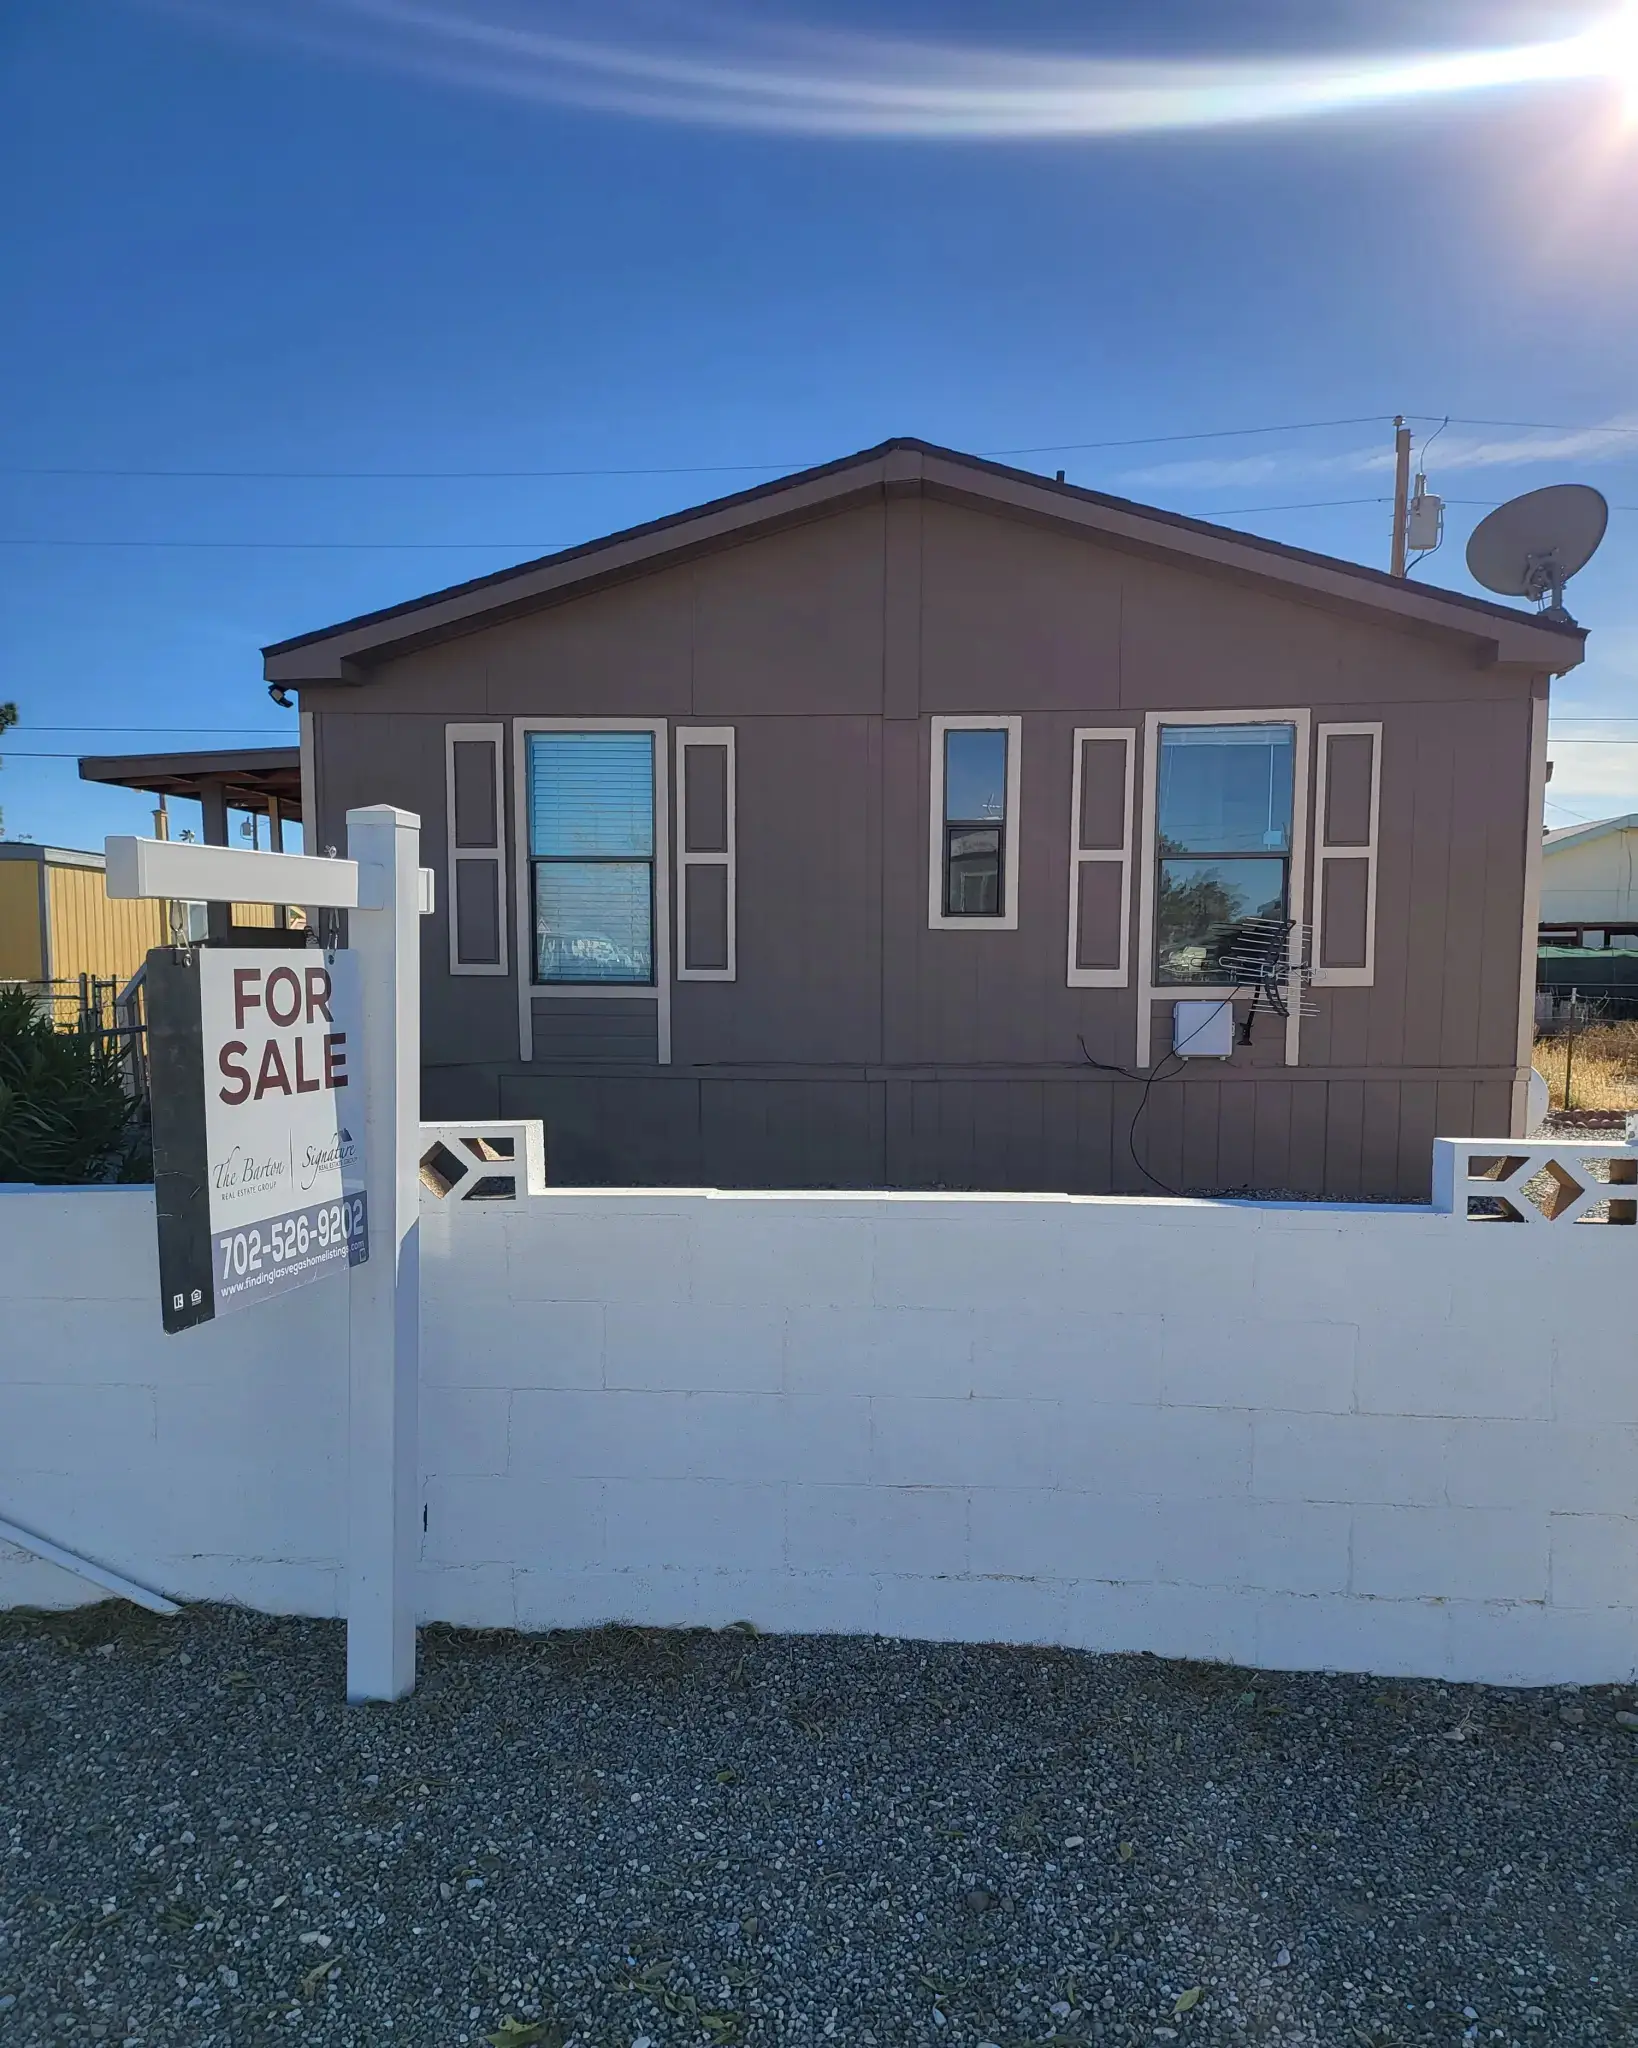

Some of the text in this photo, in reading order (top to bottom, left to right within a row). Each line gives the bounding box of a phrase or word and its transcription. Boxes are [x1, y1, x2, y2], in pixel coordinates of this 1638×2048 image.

[233, 966, 334, 1030] FOR
[218, 1032, 349, 1106] SALE
[213, 1146, 285, 1189] The Barton
[221, 1181, 277, 1201] REAL ESTATE GROUP
[300, 1142, 356, 1190] Signature
[220, 1198, 364, 1280] 702-526-9202
[220, 1240, 365, 1298] www.findinglasvegashomelistings.com
